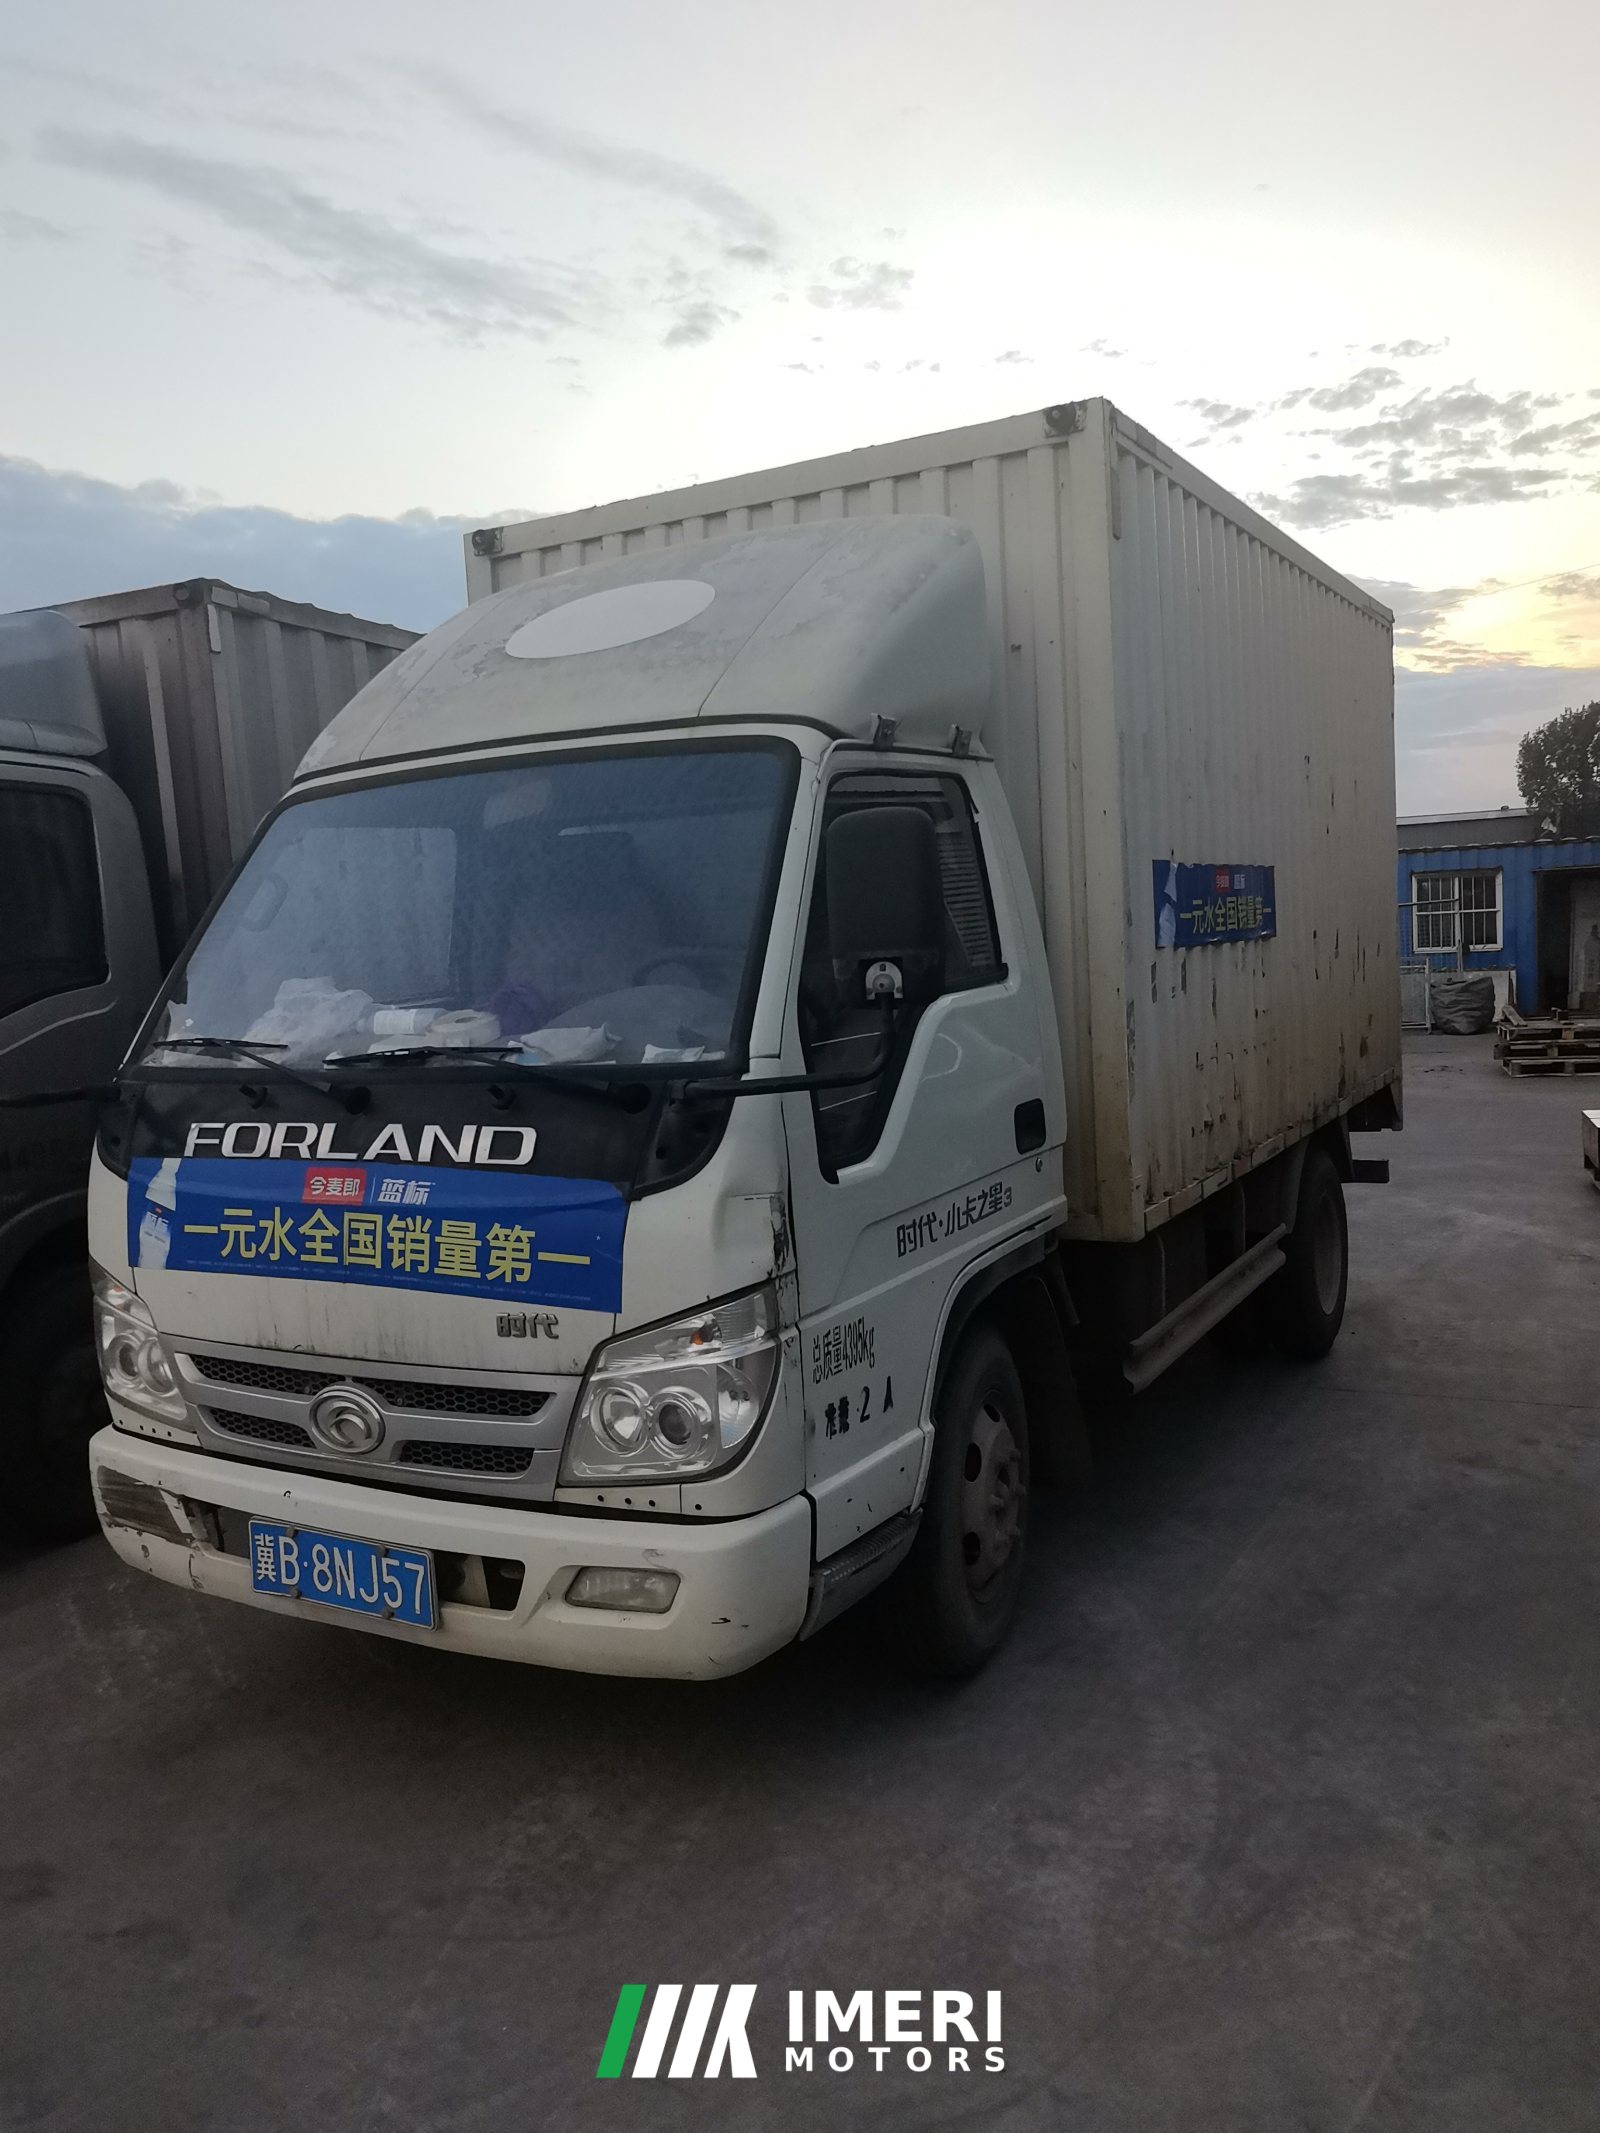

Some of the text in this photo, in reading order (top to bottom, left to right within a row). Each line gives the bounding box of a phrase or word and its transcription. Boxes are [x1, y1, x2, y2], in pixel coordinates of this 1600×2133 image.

[184, 1122, 537, 1165] FORLAND
[310, 1176, 432, 1205] 今麦郎 蓝标
[184, 1208, 590, 1284] 一元水全国销量第一
[496, 1312, 559, 1340] 时代
